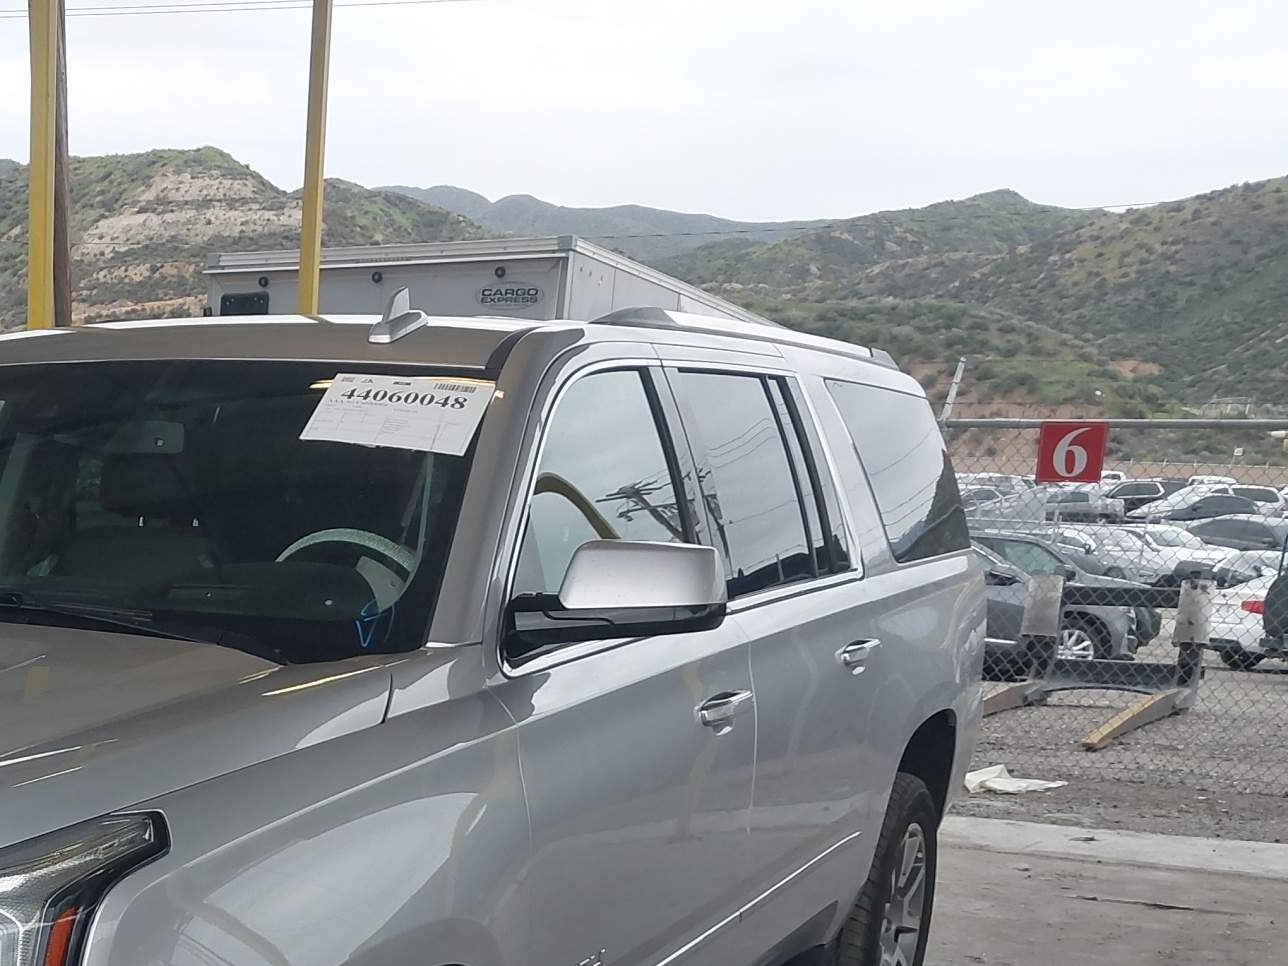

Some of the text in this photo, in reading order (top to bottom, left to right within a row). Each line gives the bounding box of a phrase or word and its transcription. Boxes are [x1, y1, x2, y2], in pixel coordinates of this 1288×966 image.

[481, 288, 538, 297] CARGO
[340, 387, 468, 410] 44060048
[1052, 427, 1092, 478] 6
